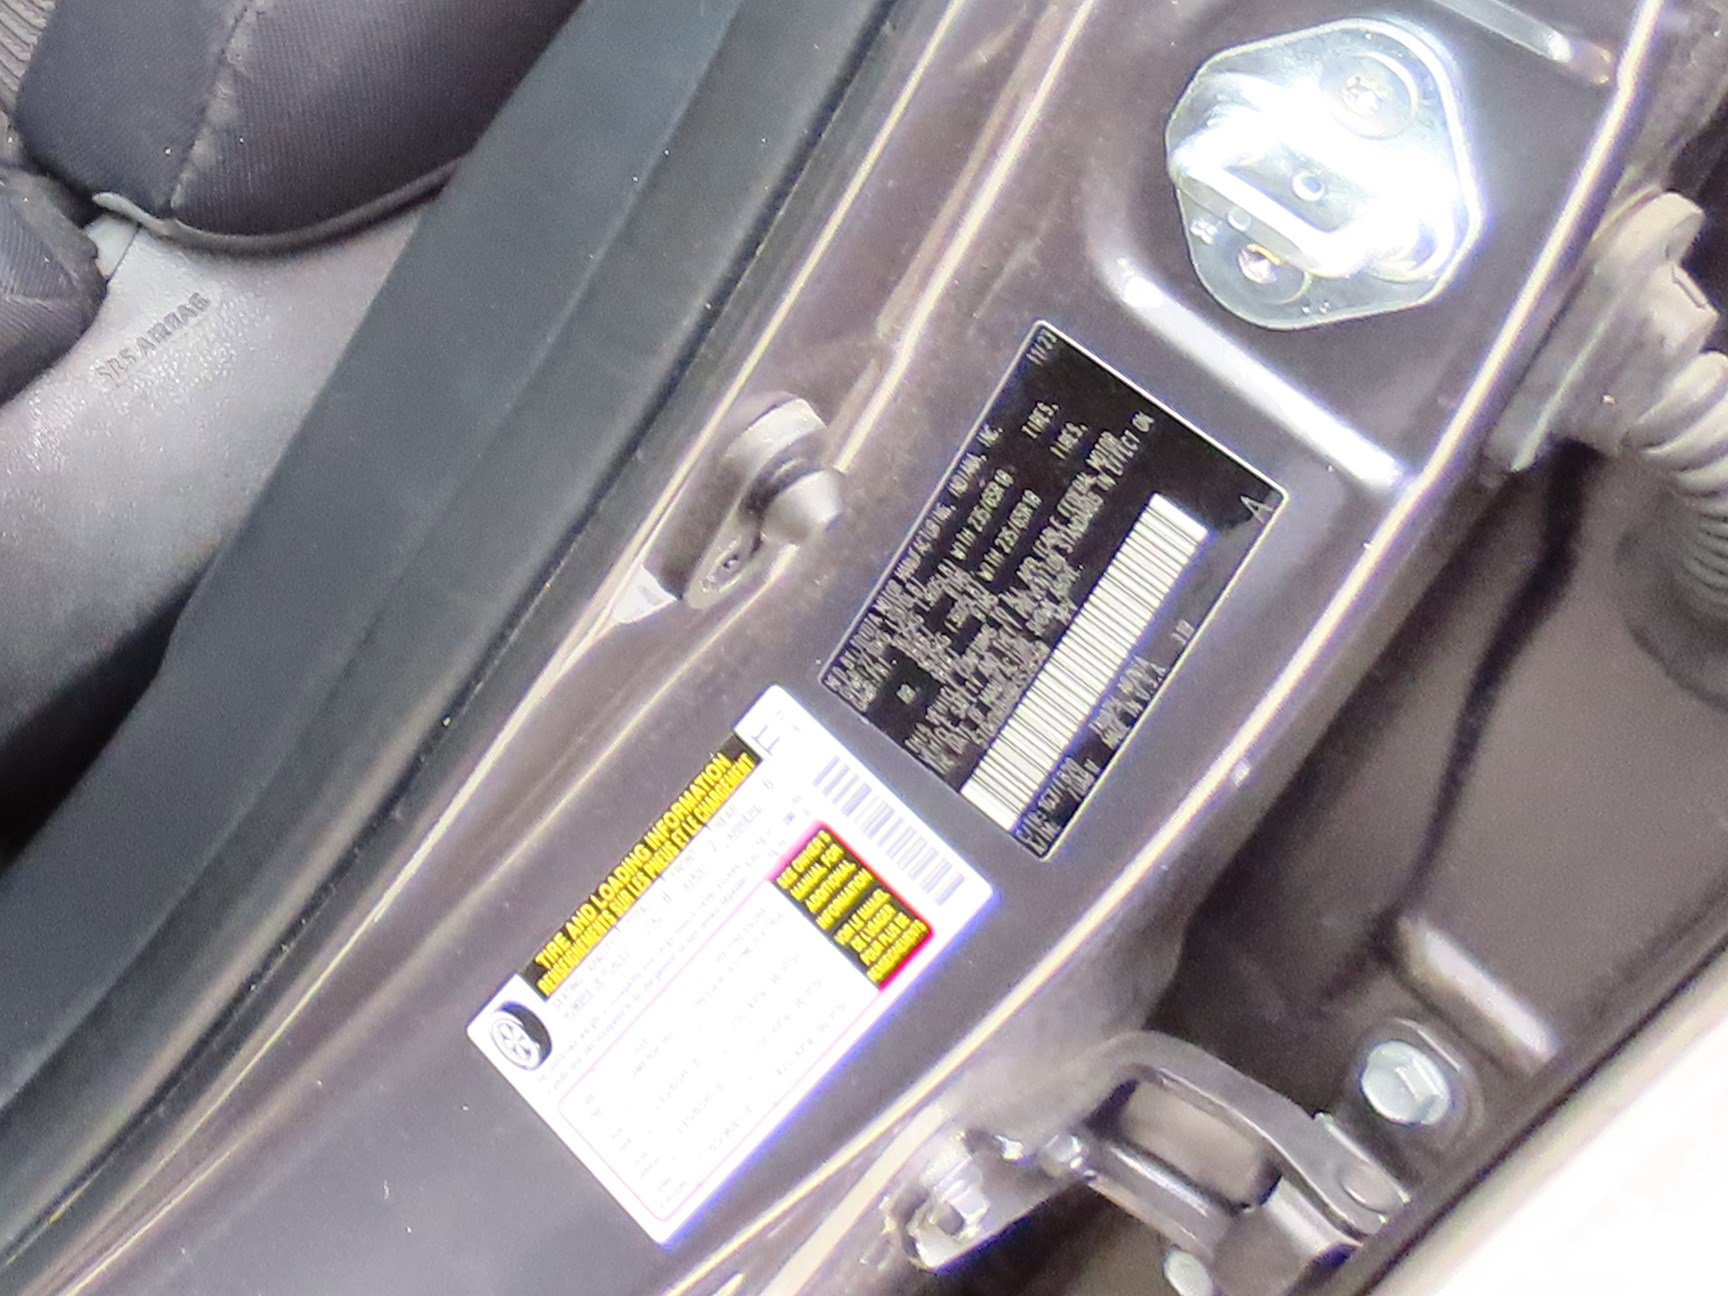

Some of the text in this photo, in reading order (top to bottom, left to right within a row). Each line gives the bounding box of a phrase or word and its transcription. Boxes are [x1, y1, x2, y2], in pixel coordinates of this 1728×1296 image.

[136, 291, 211, 356] AIRBAG
[1233, 487, 1275, 525] A
[534, 930, 571, 971] TIRE
[563, 900, 598, 939] AND
[589, 840, 652, 910] LOADING
[642, 751, 732, 850] INFORMATION
[537, 907, 617, 996] RENSEIGNEMENTS
[608, 887, 635, 917] SUR
[626, 869, 652, 897] LES
[642, 838, 679, 879] PNEUS
[670, 826, 691, 848] ET
[681, 813, 702, 836] LE
[692, 752, 757, 823] CHARGEMENT
[788, 858, 829, 903] MANUAL
[818, 840, 846, 869] FOR
[802, 855, 858, 914] ADDITIONAL
[813, 866, 875, 932] INFORMATION
